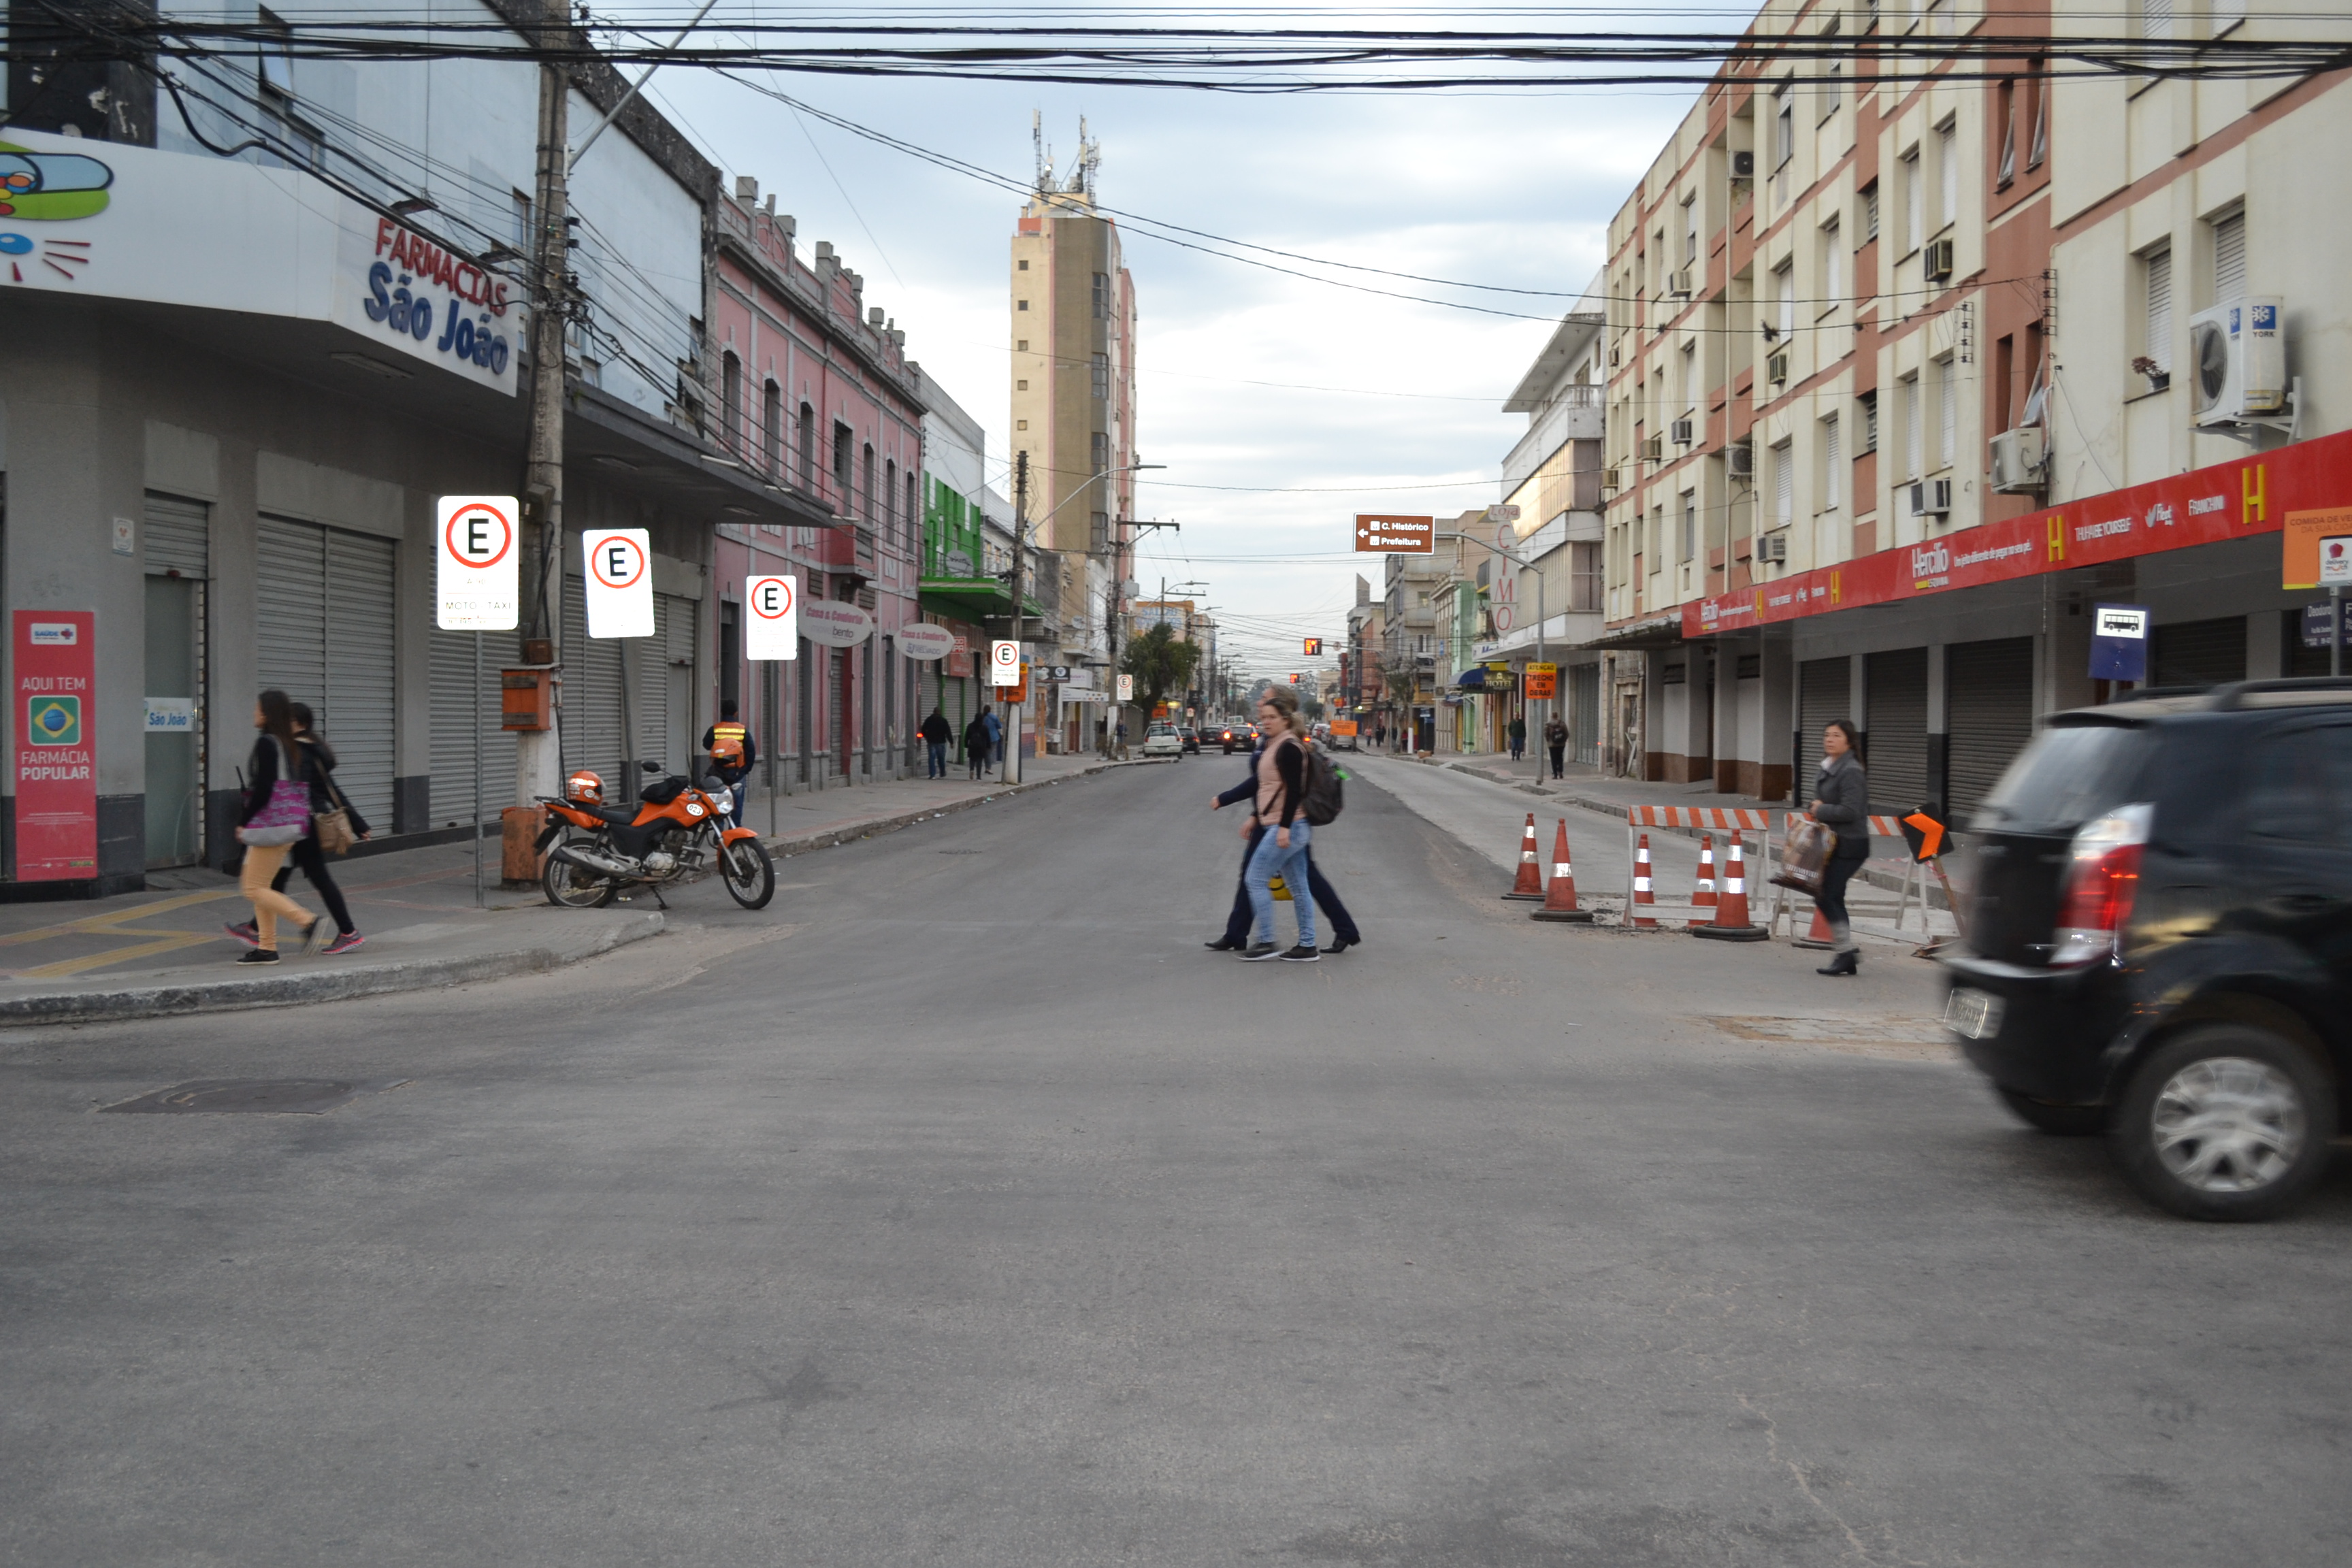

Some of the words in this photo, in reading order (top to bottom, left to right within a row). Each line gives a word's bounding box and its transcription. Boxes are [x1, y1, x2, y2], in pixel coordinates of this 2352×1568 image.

[376, 218, 508, 317] FARMACIAS
[363, 261, 432, 341] São
[438, 299, 509, 375] João
[2242, 464, 2266, 525] H
[1490, 505, 1519, 519] Loja
[1382, 522, 1390, 530] C.
[1392, 523, 1429, 532] Histórico
[2289, 518, 2325, 526] COMIDA
[2327, 515, 2339, 523] DE
[468, 518, 490, 554] E
[1381, 537, 1422, 546] Prefeitura
[2047, 514, 2065, 562] H
[608, 547, 627, 576] E
[1830, 570, 1841, 605] H
[446, 602, 476, 610] MOTO
[764, 587, 778, 610] E
[1755, 589, 1763, 619] H
[805, 606, 823, 620] Casa
[831, 610, 864, 625] Conforto
[900, 630, 915, 639] Casa
[921, 632, 947, 642] Conforto
[1002, 648, 1010, 660] E
[22, 678, 54, 691] AQUI
[57, 678, 86, 691] TEM
[149, 711, 165, 726] São
[167, 712, 187, 726] João
[22, 748, 91, 765] FARMÁCIA
[22, 766, 90, 781] POPULAR
[689, 805, 702, 815] 023
